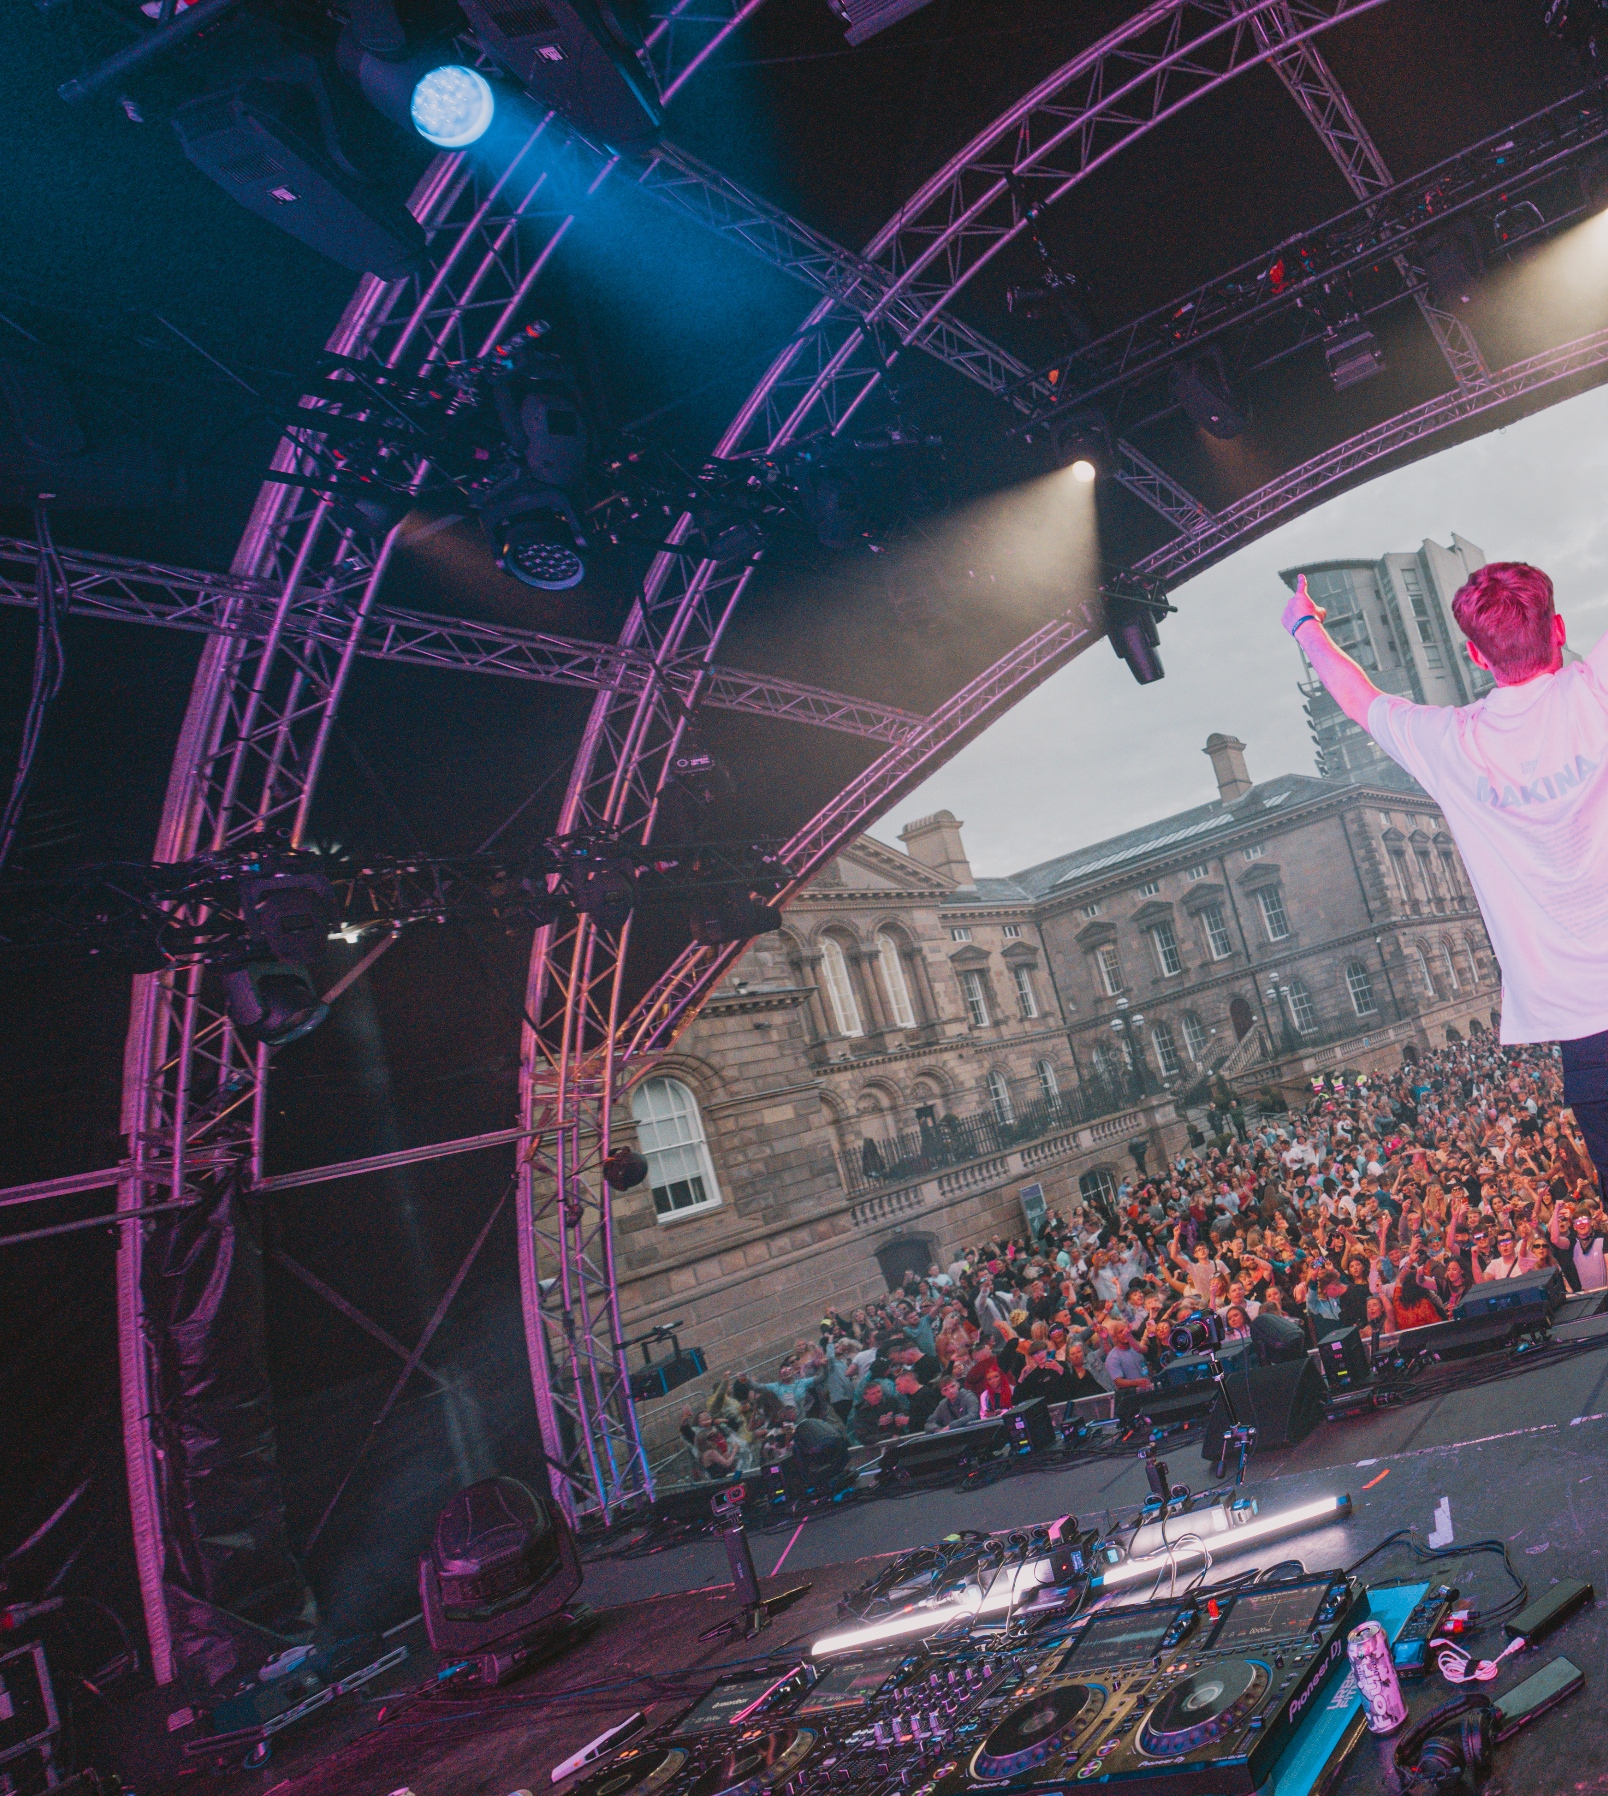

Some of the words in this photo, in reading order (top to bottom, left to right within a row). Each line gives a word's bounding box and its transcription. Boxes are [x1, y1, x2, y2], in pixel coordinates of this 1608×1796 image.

[1477, 754, 1599, 808] MAKINA
[1288, 1656, 1330, 1723] Pioneer
[1330, 1639, 1342, 1660] DJ
[1326, 1670, 1355, 1710] URBA
